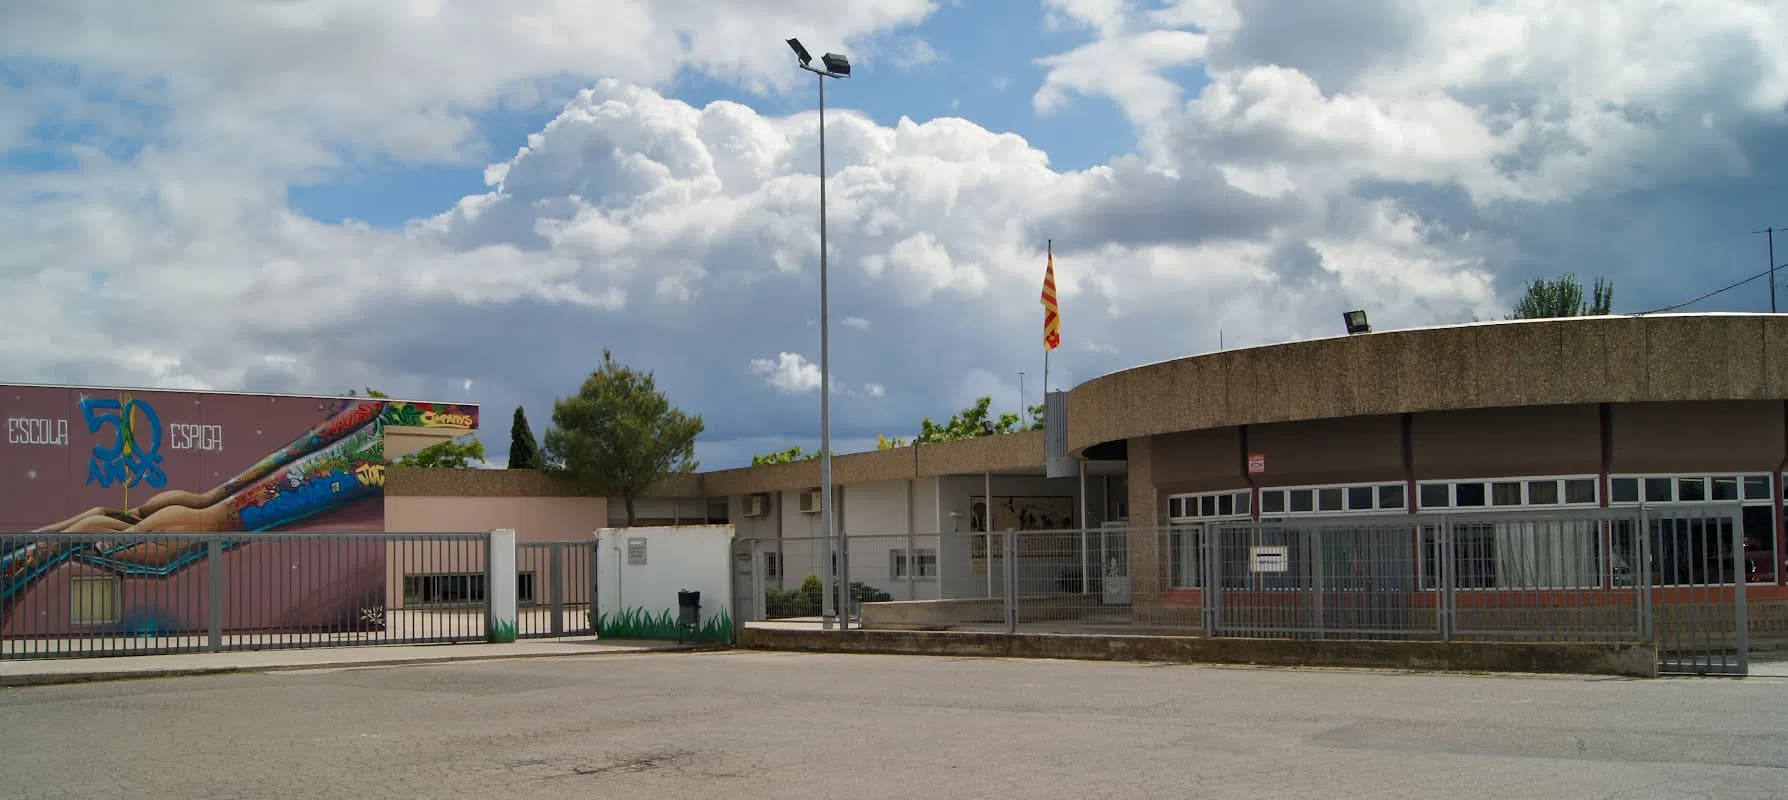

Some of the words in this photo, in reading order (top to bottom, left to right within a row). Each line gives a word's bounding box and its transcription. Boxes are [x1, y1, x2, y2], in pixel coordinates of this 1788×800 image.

[8, 418, 69, 445] ESCOLA
[79, 397, 162, 460] 50
[170, 423, 223, 450] ESPIGA
[85, 453, 168, 489] ANYS
